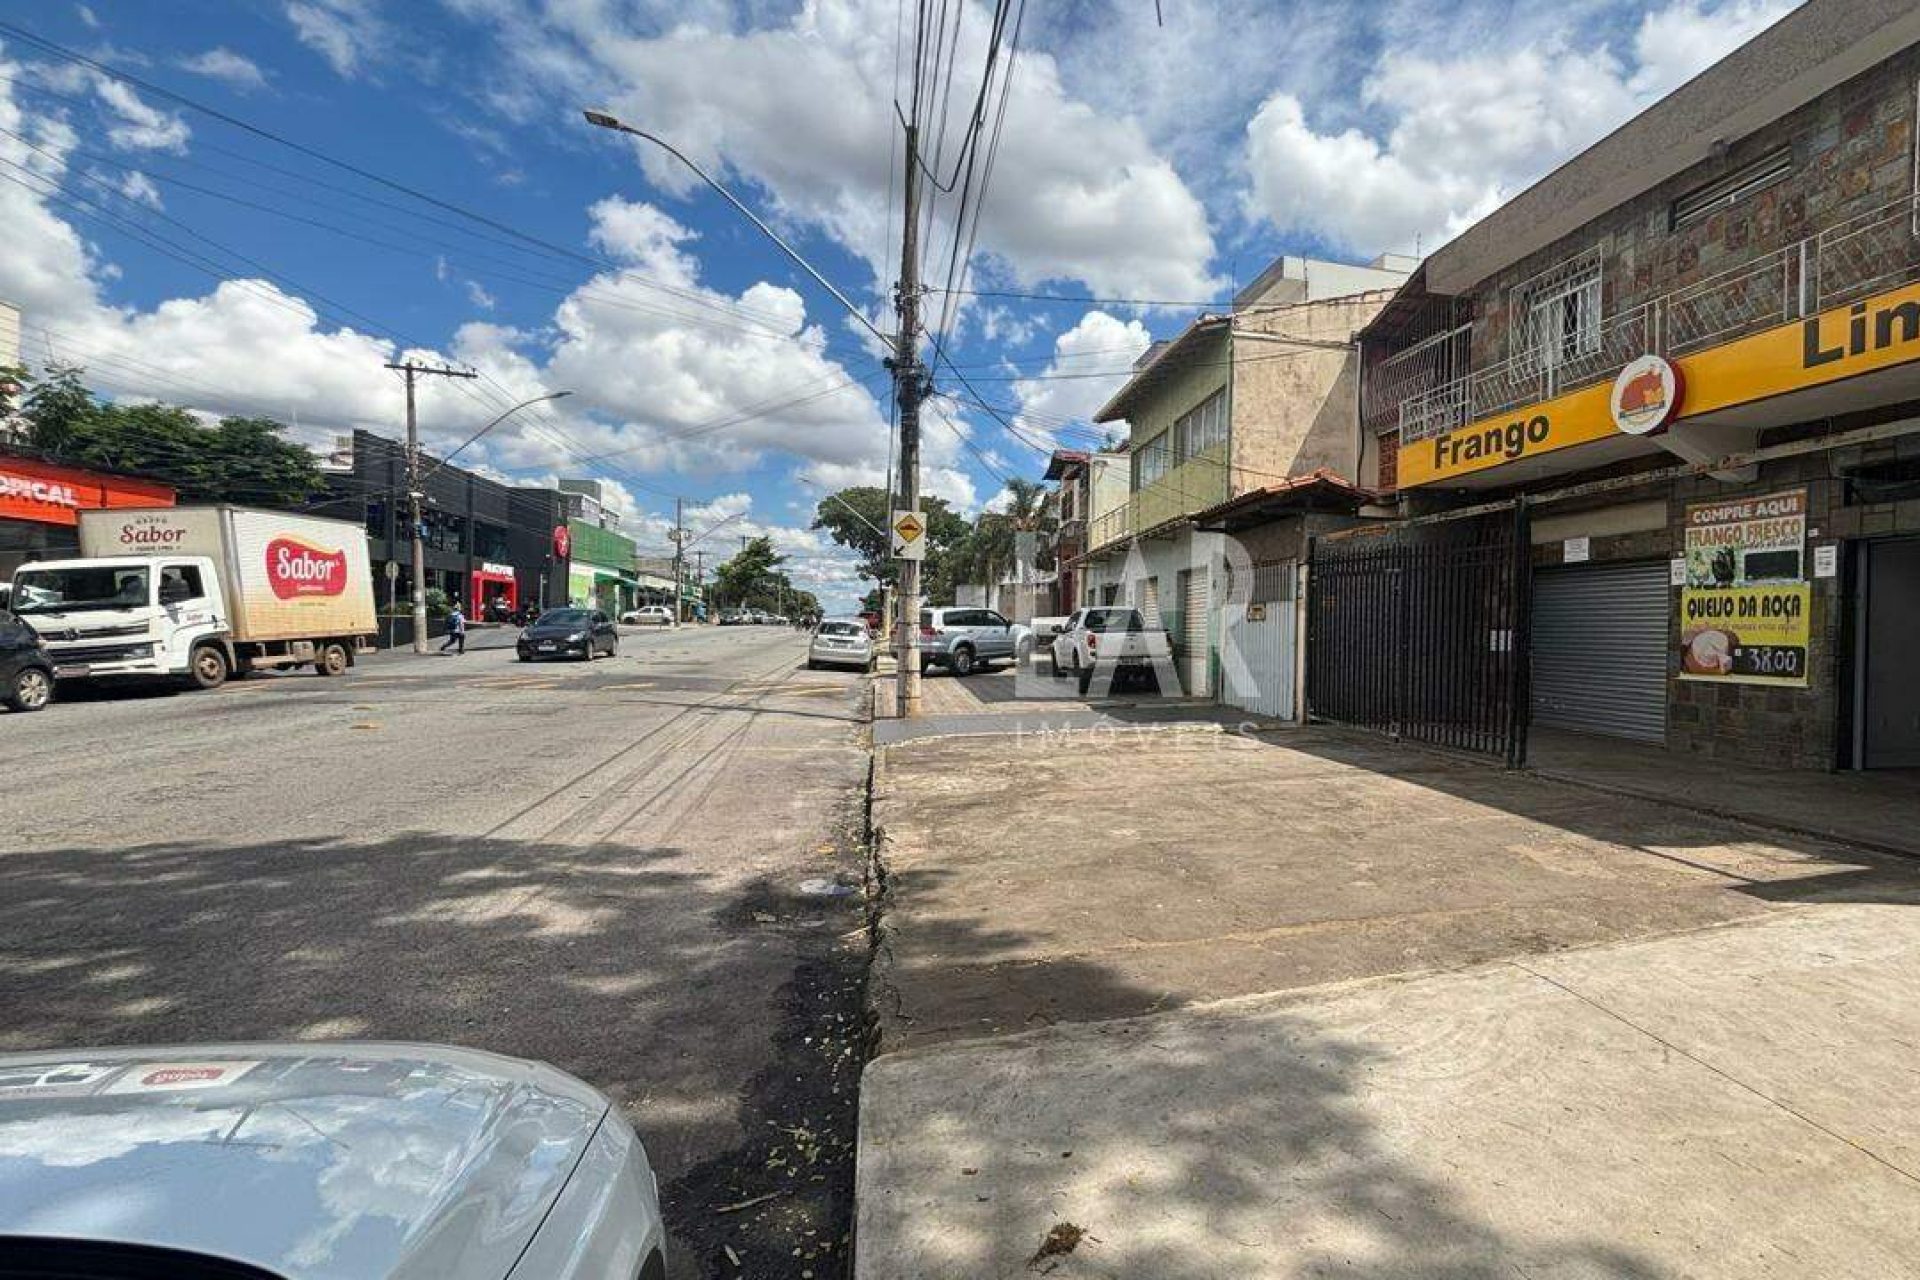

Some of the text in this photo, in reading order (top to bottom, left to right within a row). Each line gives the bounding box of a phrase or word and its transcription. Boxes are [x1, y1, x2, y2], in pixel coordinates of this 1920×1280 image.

[1434, 415, 1549, 469] Frango
[1692, 497, 1798, 523] COMPRE AQUI
[120, 524, 186, 544] Sabor
[1687, 524, 1742, 548] FRANGO
[1746, 518, 1801, 545] FRESCO
[277, 546, 335, 581] Sabor
[1687, 597, 1735, 620] QUEIJO
[1738, 595, 1758, 617] DA
